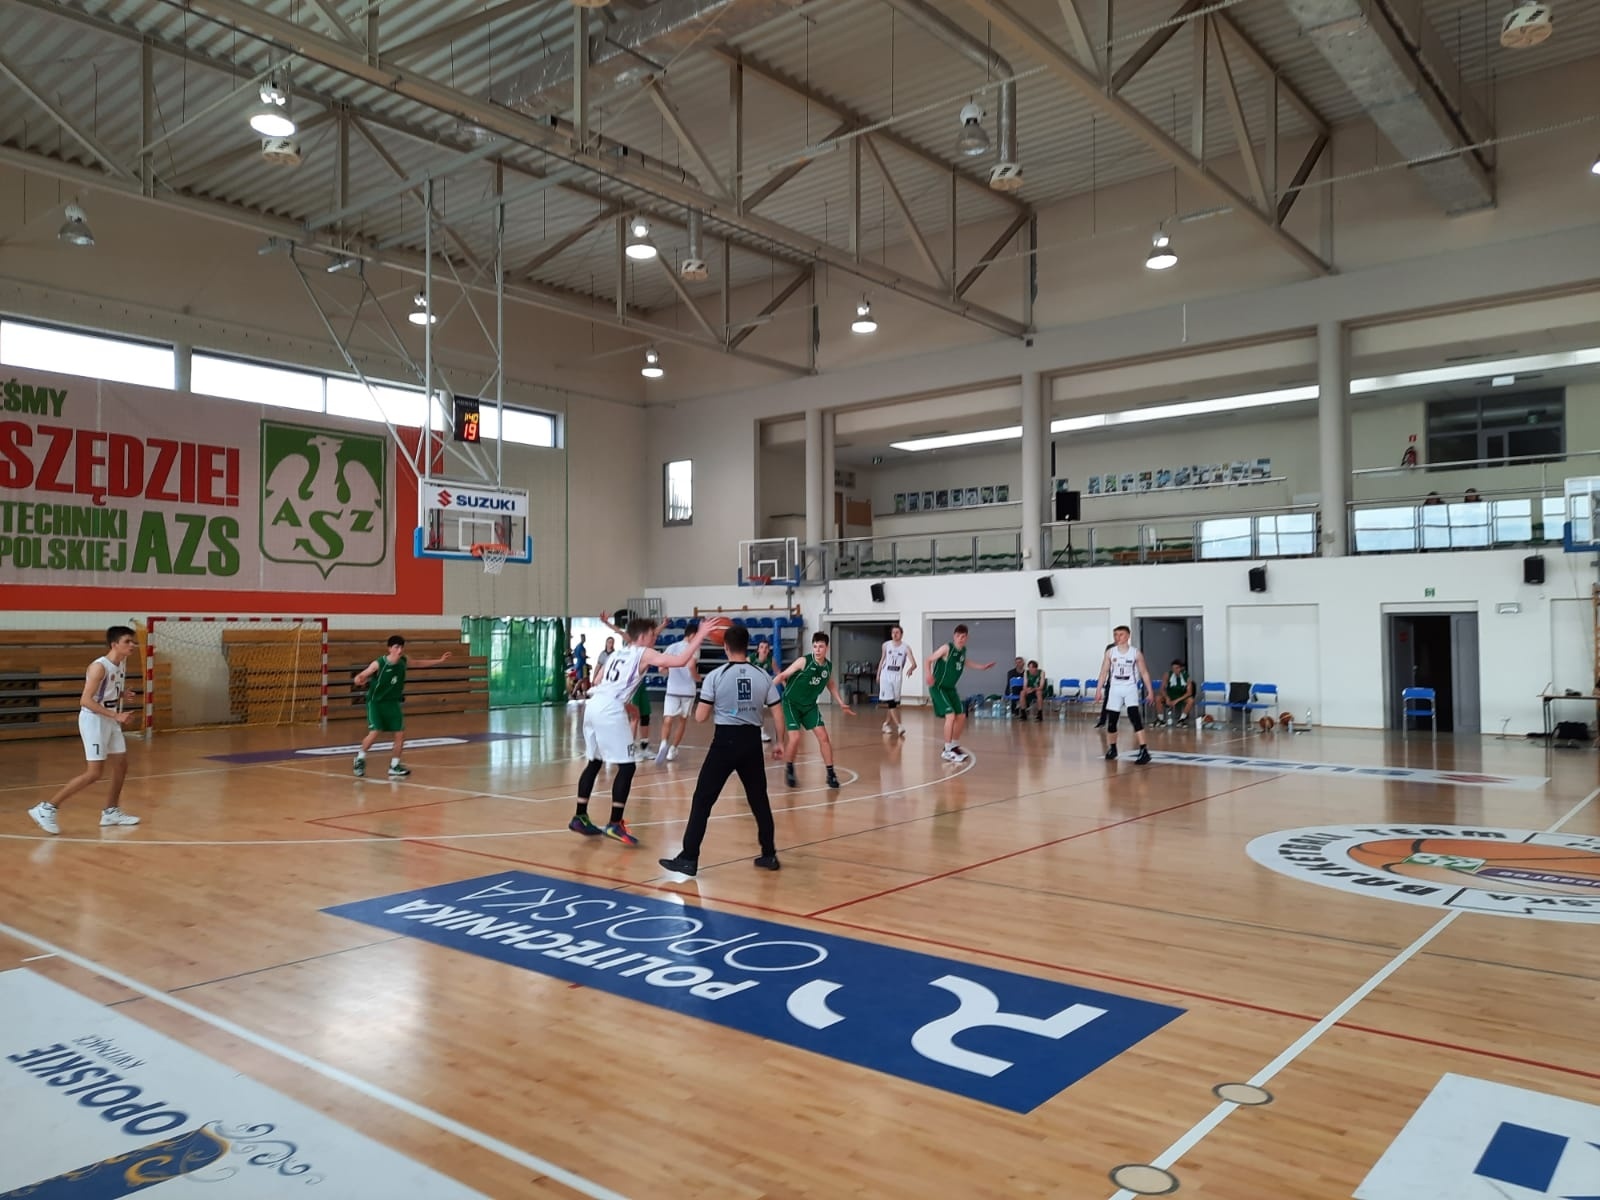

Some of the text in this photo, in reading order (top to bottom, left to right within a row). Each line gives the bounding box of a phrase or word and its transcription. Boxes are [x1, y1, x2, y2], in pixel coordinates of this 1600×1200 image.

[0, 378, 68, 418] ŚMY
[464, 423, 477, 440] 19
[0, 501, 128, 540] TECHNIKI
[456, 494, 516, 512] SUZUKI
[131, 511, 240, 577] AZS
[606, 659, 625, 682] 15
[92, 743, 100, 756] 7
[1278, 832, 1442, 897] BASKETBALL
[455, 879, 829, 972] OPOLSKA
[383, 898, 760, 1001] POLITECHNIKA
[5, 1042, 189, 1136] OPOLSKIE
